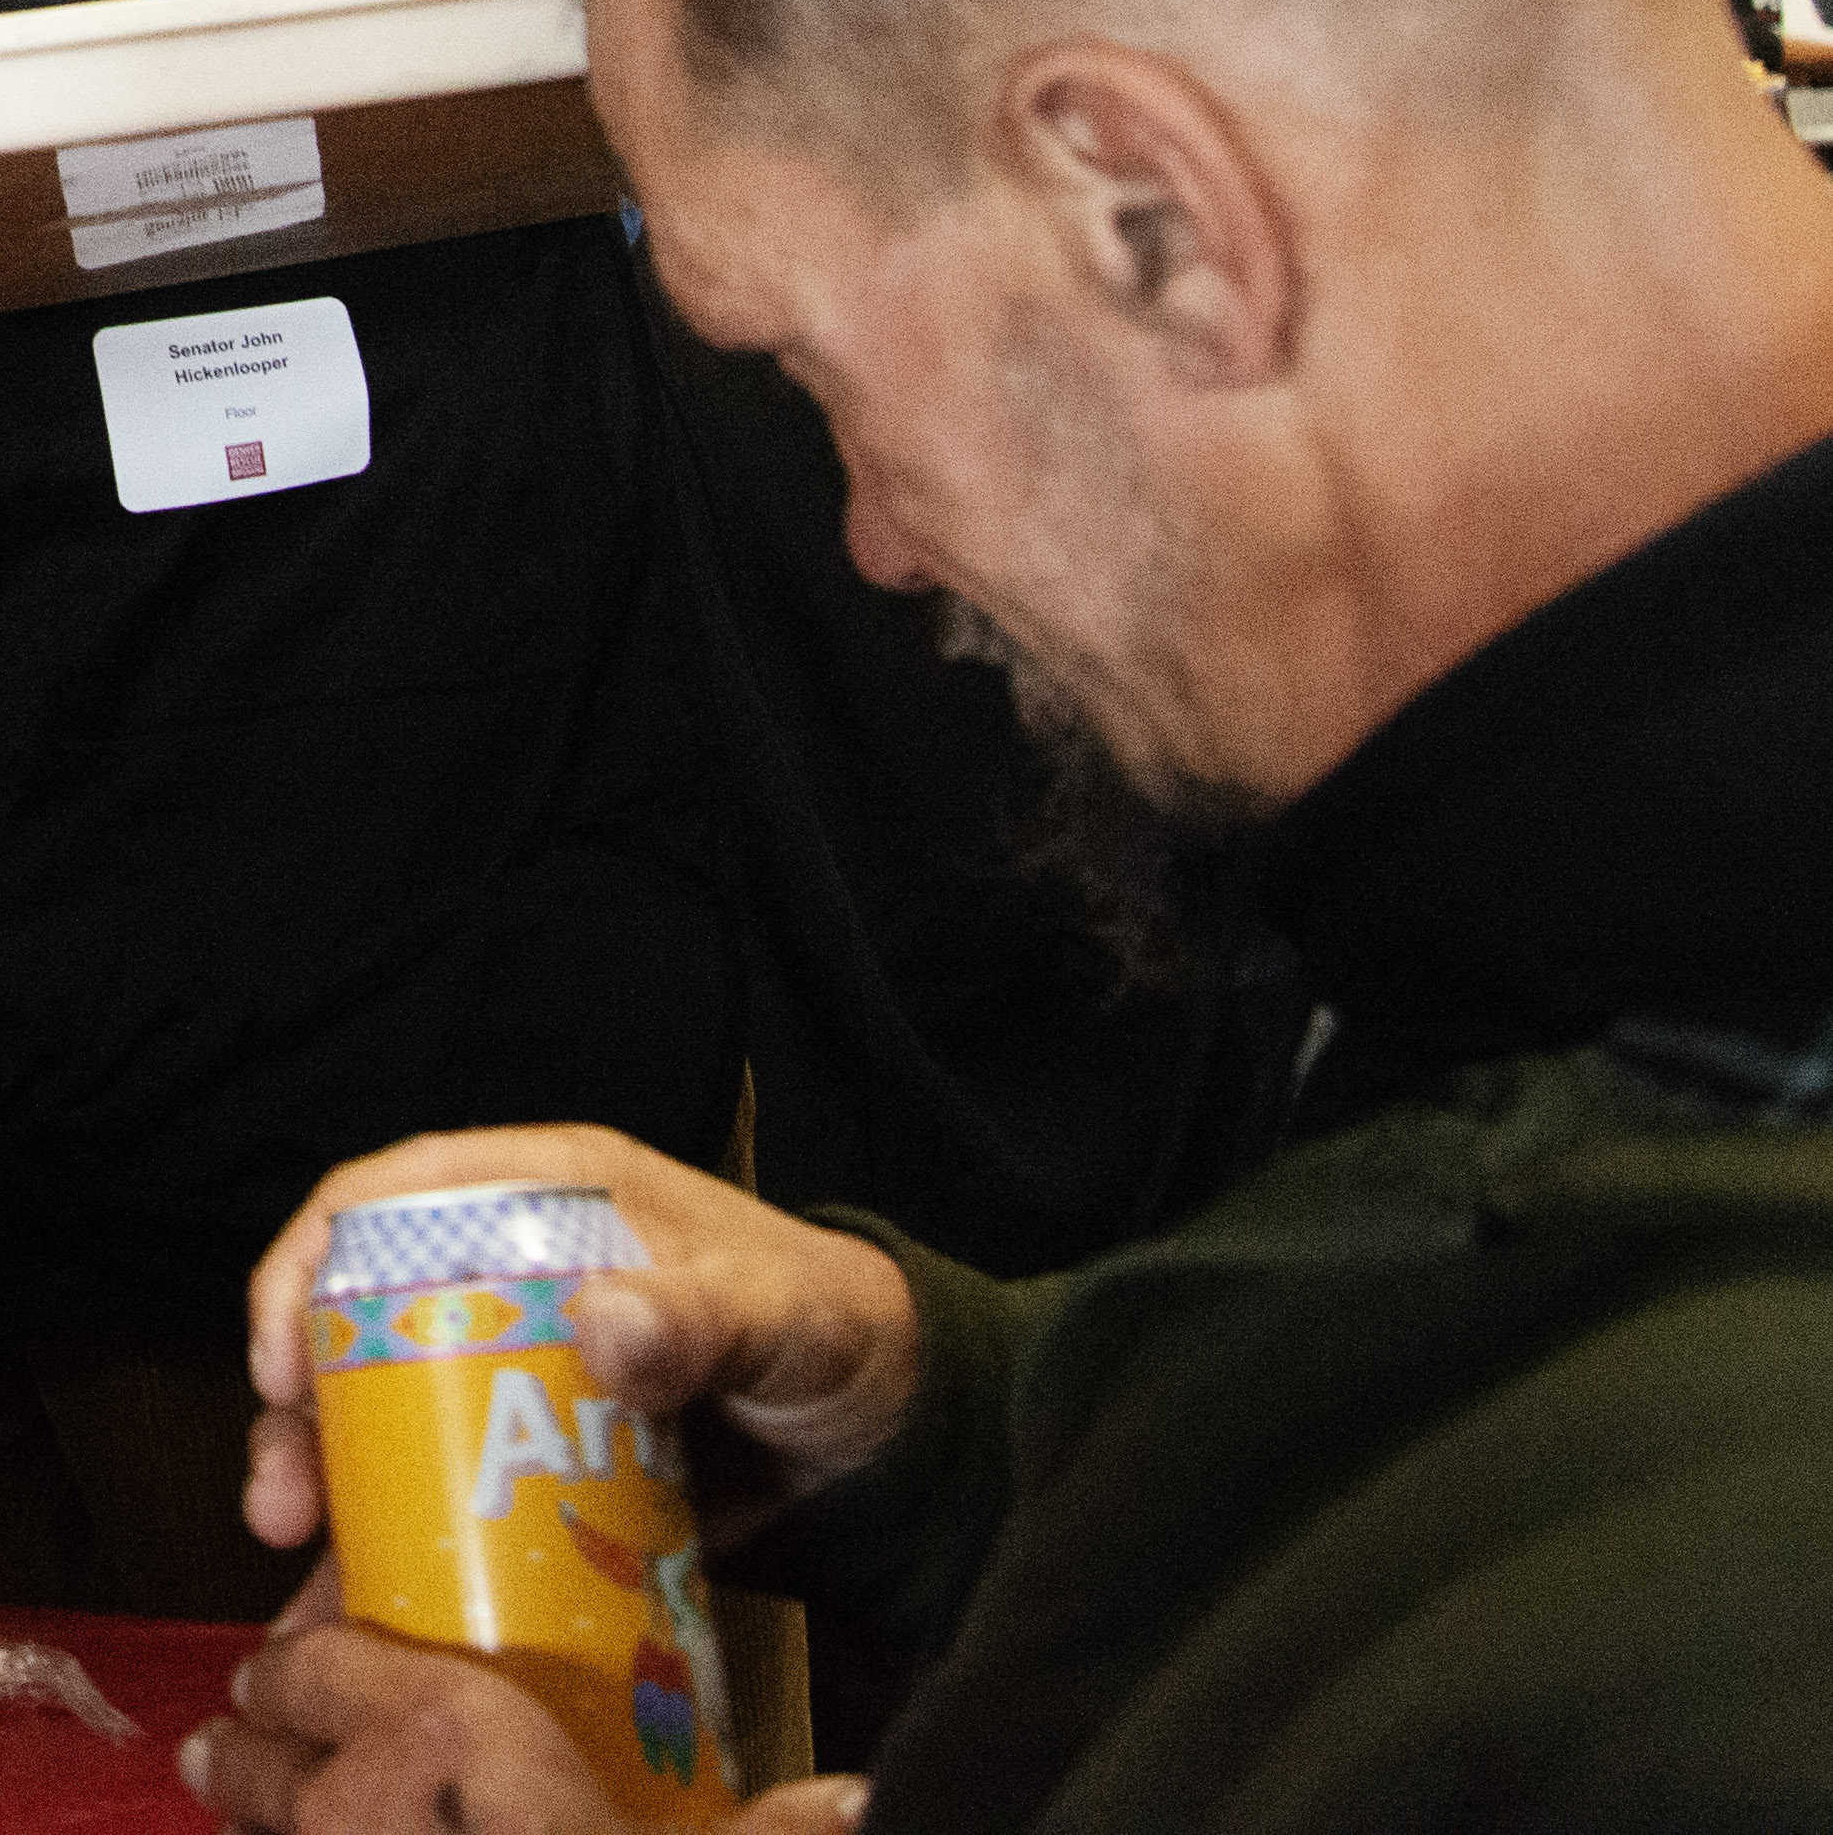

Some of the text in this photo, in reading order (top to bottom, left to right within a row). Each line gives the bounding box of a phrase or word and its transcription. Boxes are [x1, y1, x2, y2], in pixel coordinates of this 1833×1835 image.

[168, 331, 284, 360] Senator John
[174, 356, 289, 384] Hickenlooper
